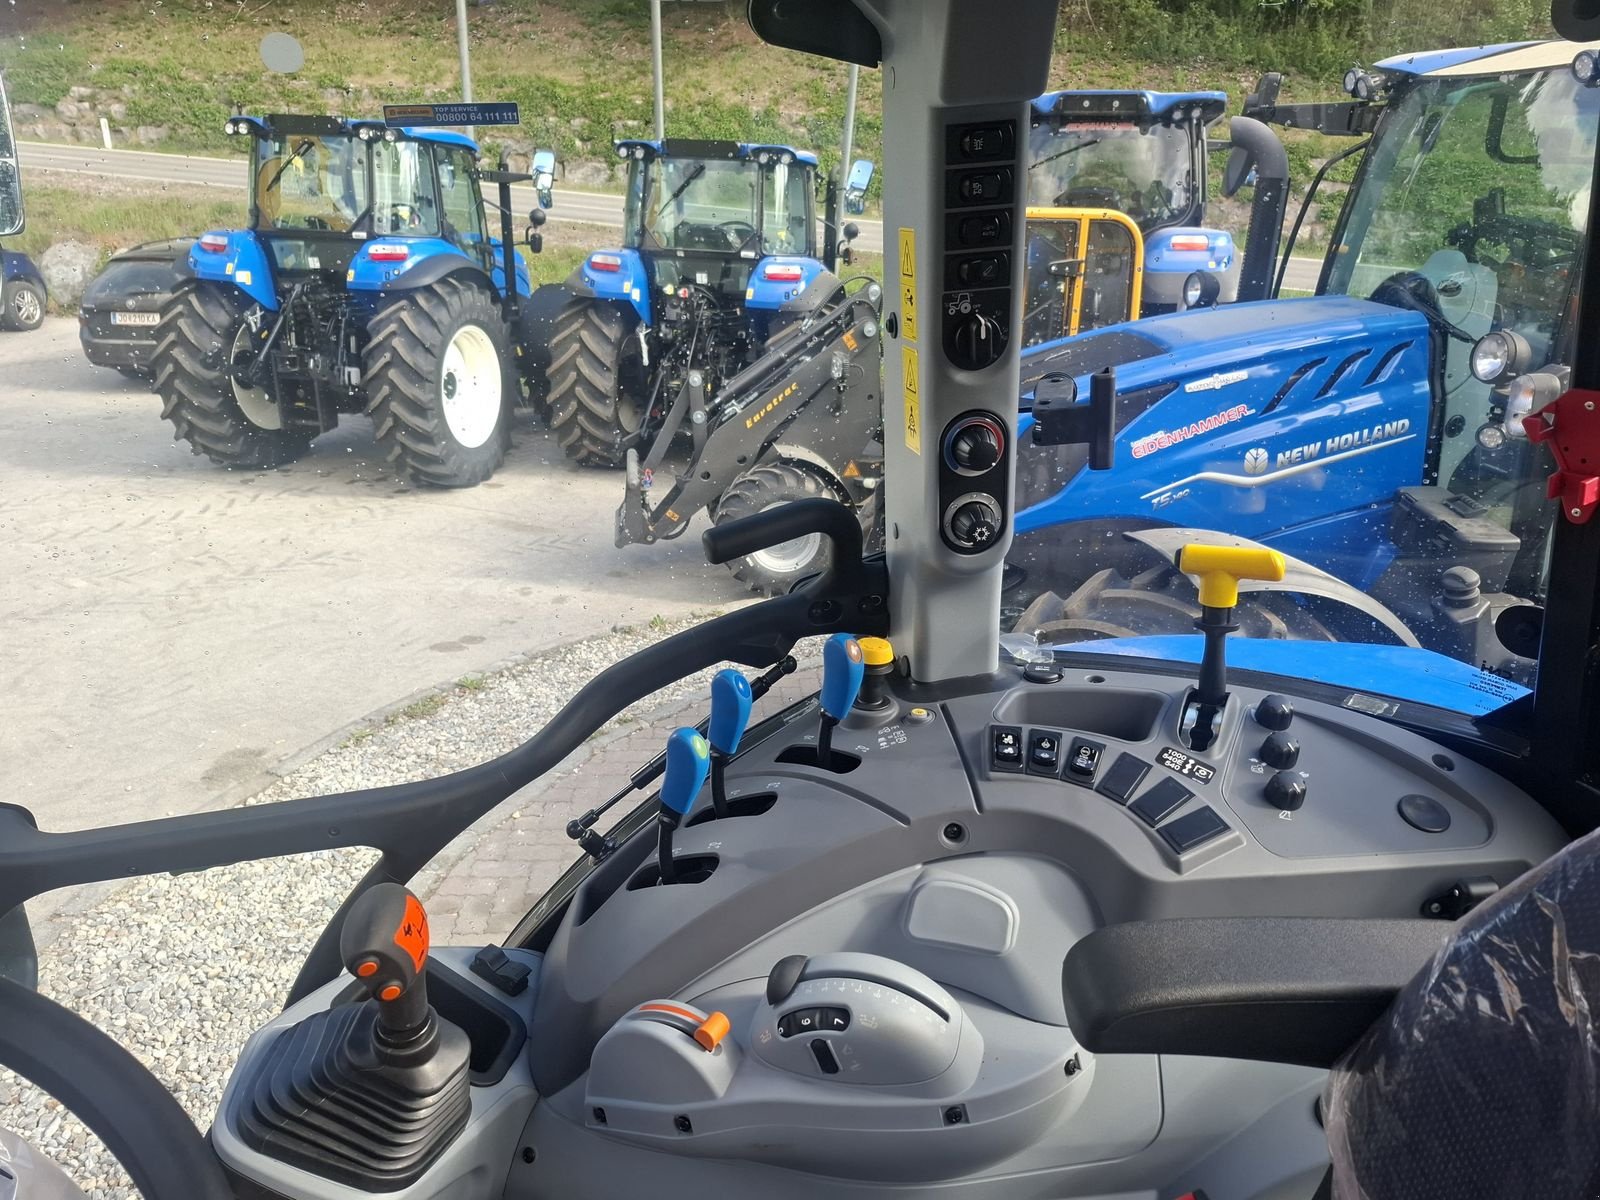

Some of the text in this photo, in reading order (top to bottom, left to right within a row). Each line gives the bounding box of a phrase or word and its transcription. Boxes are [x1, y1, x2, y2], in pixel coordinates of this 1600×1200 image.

[436, 113, 467, 122] 00800
[470, 113, 483, 121] 64
[485, 112, 500, 121] 111
[503, 112, 518, 121] 111
[745, 382, 799, 429] Eurotrac
[1132, 404, 1249, 458] EIDENHAMMER
[1276, 418, 1410, 468] NEW HOLLAND
[1164, 760, 1180, 771] 540
[1168, 749, 1187, 761] 1000
